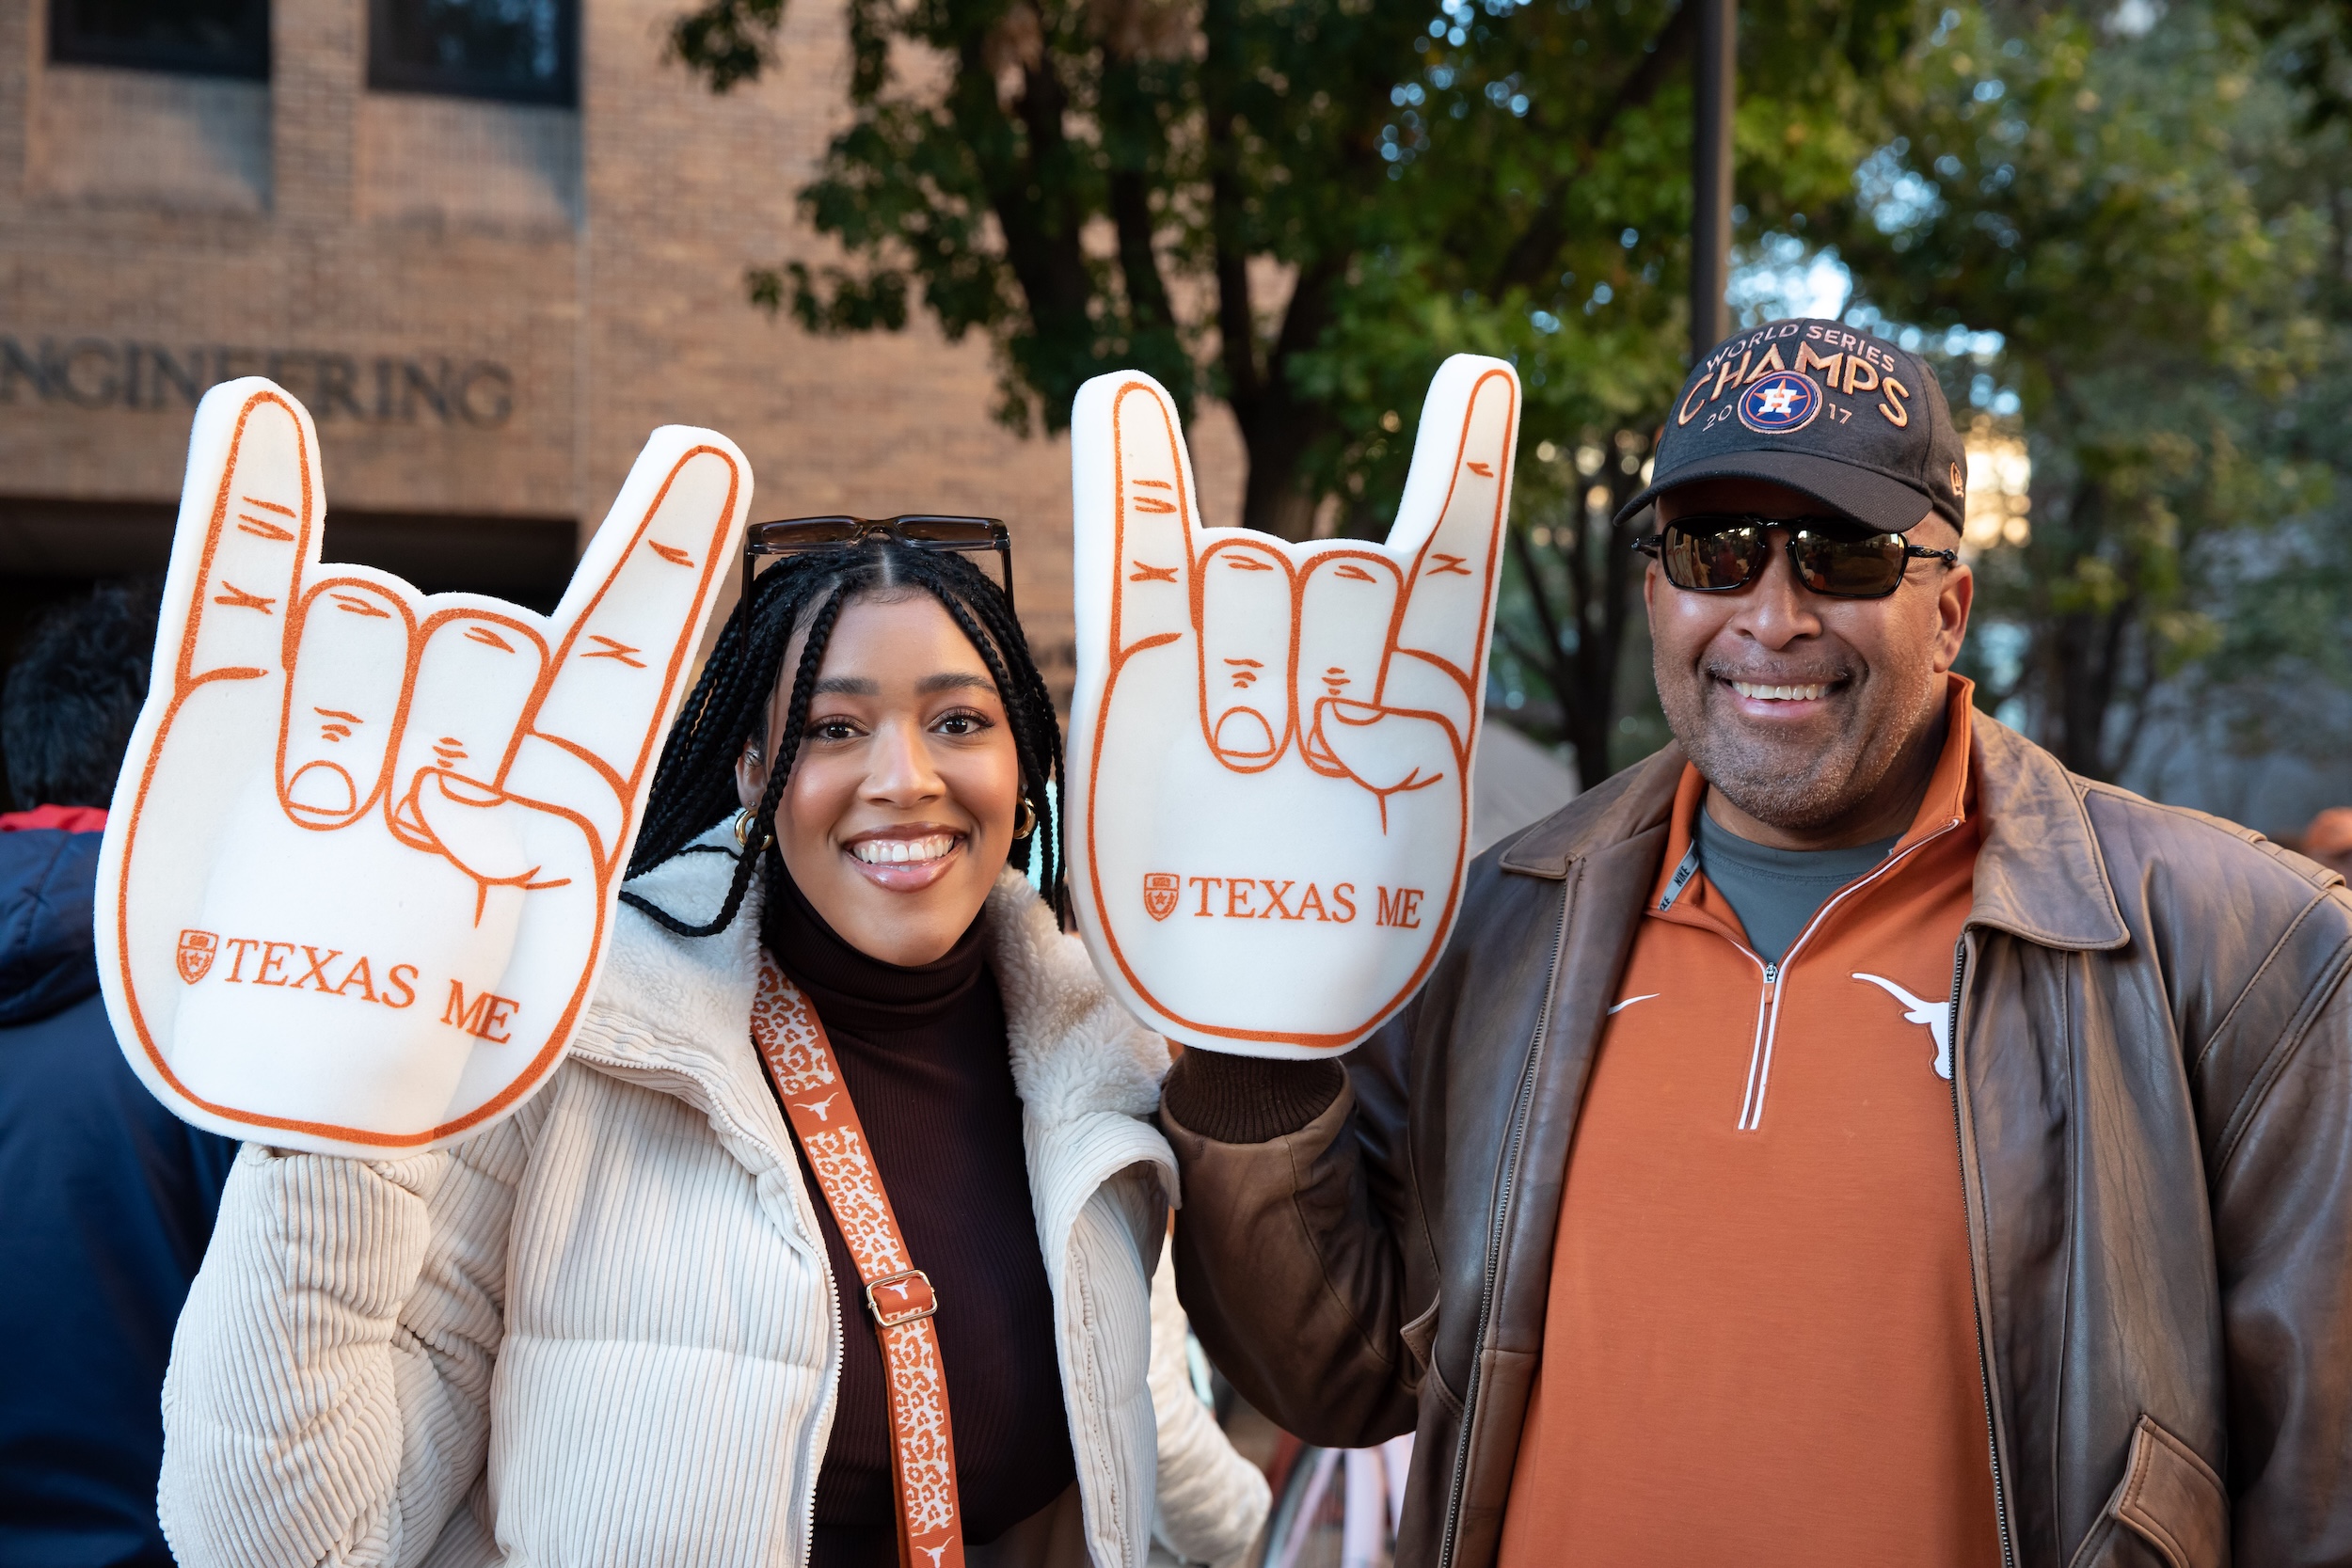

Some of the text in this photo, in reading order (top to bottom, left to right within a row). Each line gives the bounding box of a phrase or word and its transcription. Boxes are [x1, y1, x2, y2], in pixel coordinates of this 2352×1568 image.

[1707, 324, 1895, 372] WORLD SERIES
[1677, 340, 1910, 429] CHAMPS
[1702, 402, 1853, 433] 20 17
[1673, 865, 1691, 887] NIKE
[1188, 877, 1423, 928] TEXAS ME
[224, 938, 520, 1045] TEXAS ME
